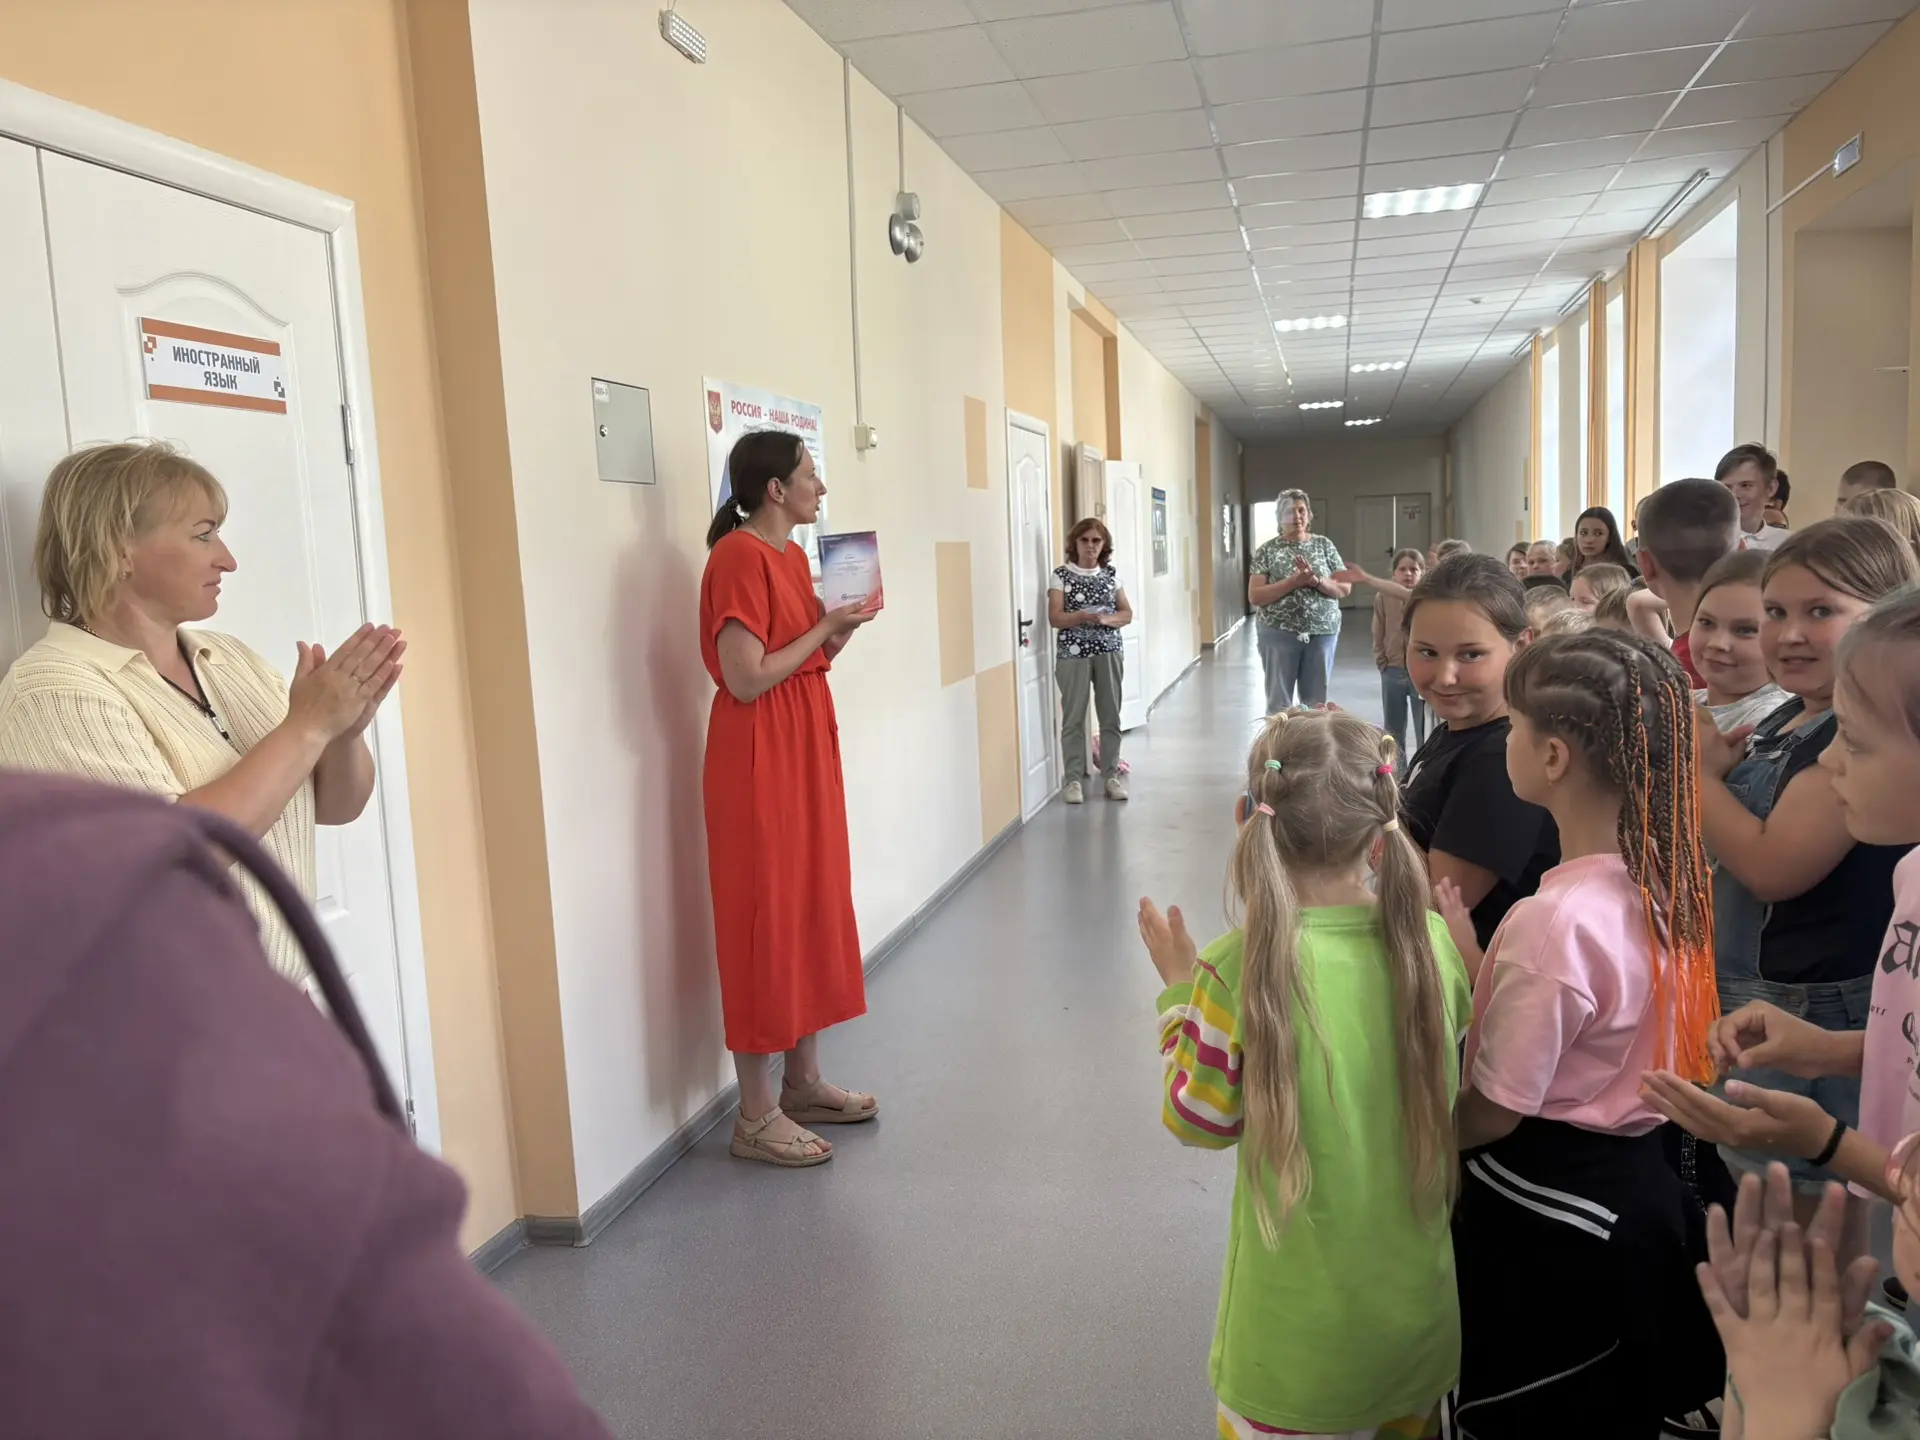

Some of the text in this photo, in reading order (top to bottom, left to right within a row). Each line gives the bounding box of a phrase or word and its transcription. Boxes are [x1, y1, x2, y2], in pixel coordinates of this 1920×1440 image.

[172, 345, 261, 374] ИНОСТРАННЫЙ
[204, 371, 238, 390] ЯЗЫК
[731, 400, 762, 419] РОССИЯ
[769, 408, 790, 424] НАША
